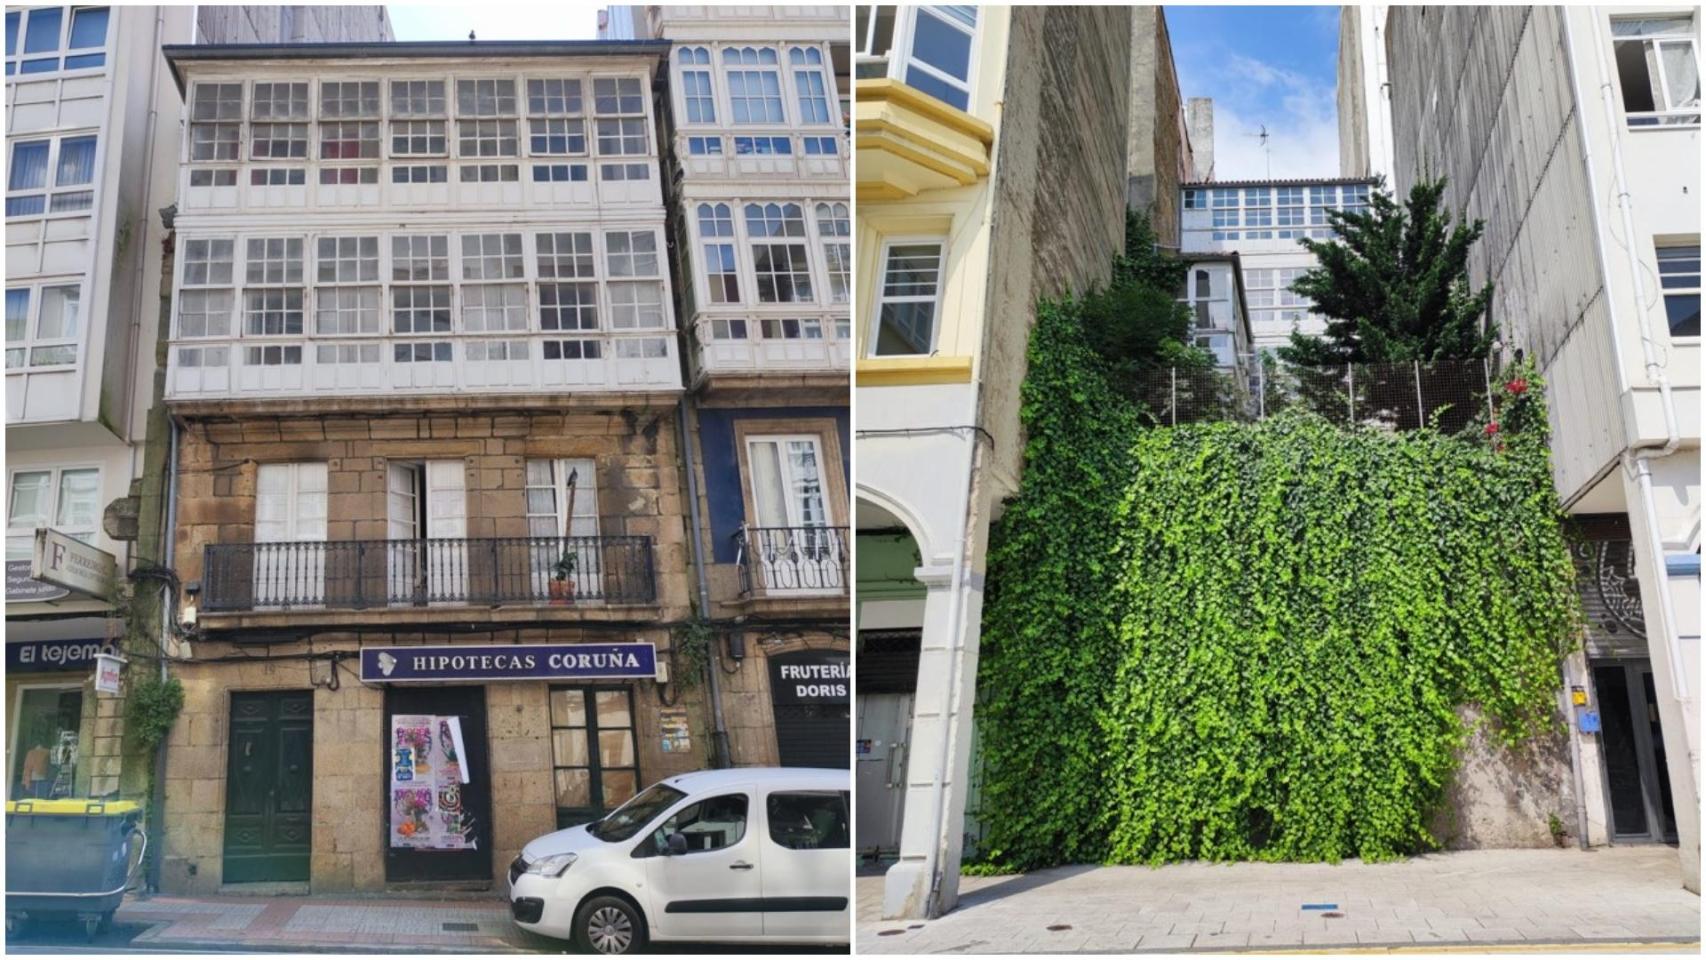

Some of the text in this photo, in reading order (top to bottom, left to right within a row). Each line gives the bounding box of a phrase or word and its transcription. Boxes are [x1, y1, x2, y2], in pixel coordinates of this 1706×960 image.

[51, 541, 66, 571] F
[20, 645, 36, 663] El
[412, 648, 641, 671] HIPOTECAS CORUÑA
[796, 684, 847, 698] DORIS
